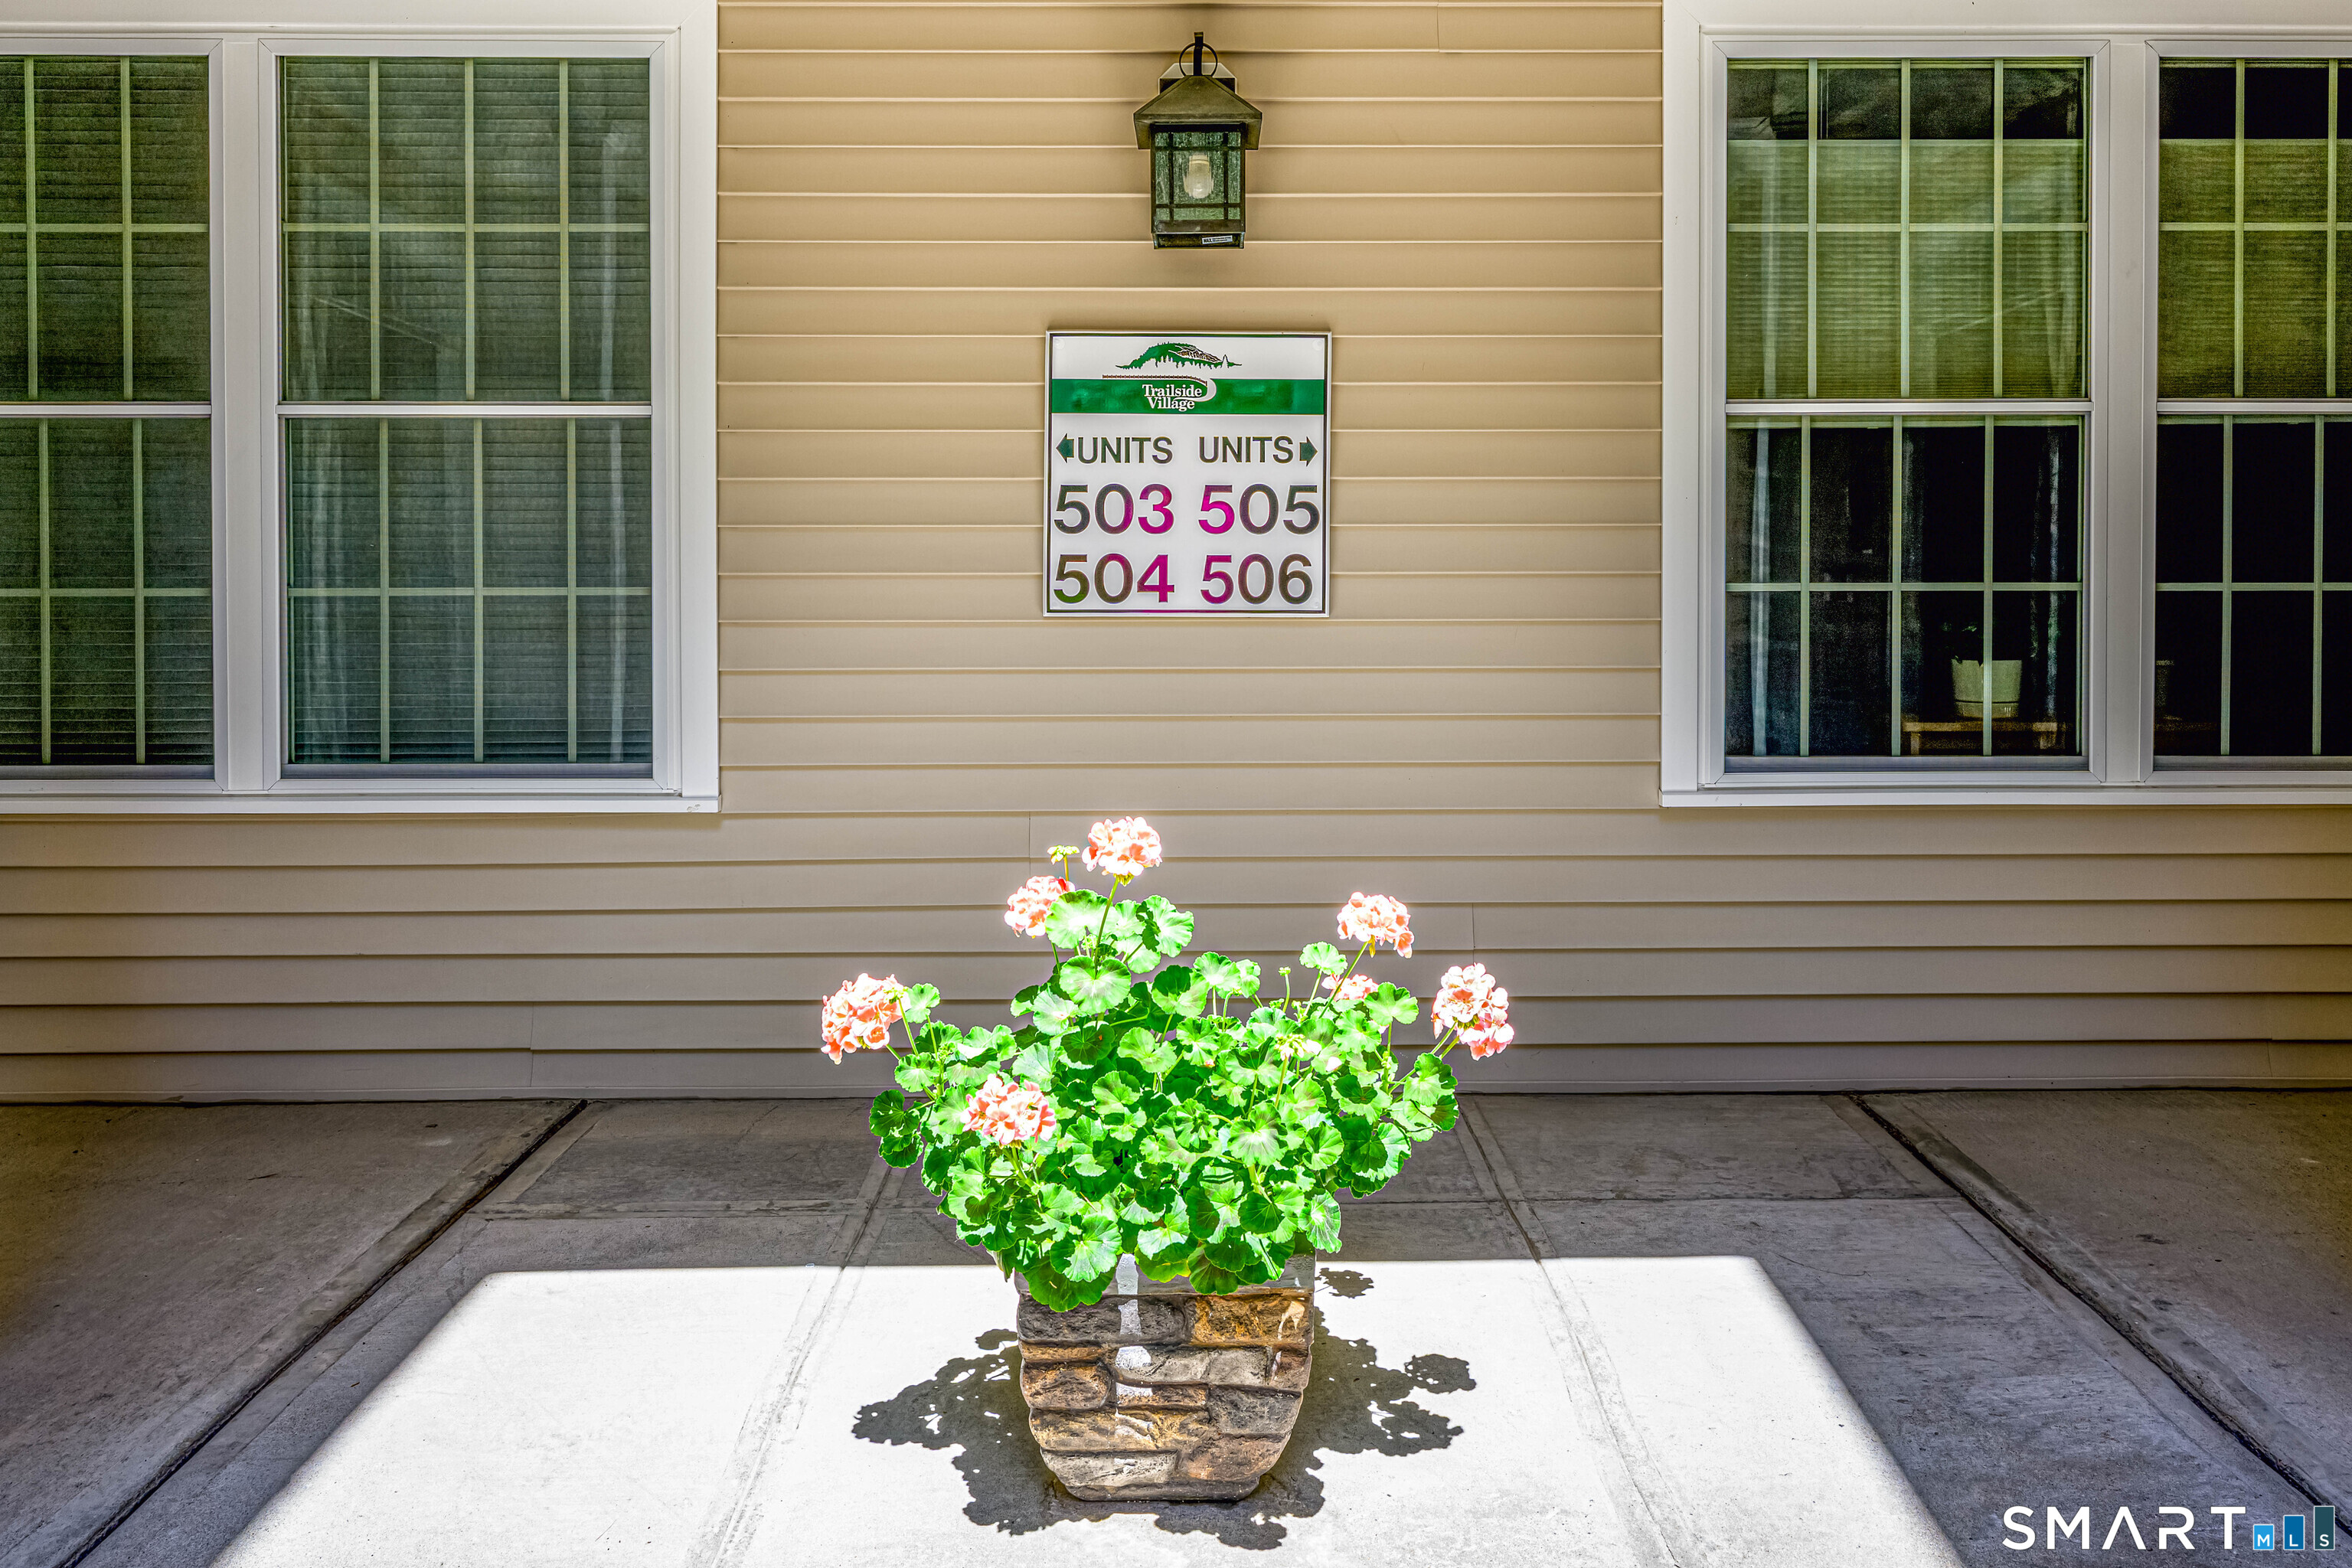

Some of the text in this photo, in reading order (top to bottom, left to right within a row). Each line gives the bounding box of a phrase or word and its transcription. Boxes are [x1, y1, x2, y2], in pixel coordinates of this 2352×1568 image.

[1142, 384, 1202, 397] Trailside
[1147, 397, 1195, 411] Village
[1077, 436, 1173, 463] UNITS
[1199, 436, 1294, 462] UNITS
[1054, 484, 1174, 534] 503
[1197, 484, 1320, 534] 505
[1054, 554, 1175, 604] 504
[1200, 554, 1313, 604] 506
